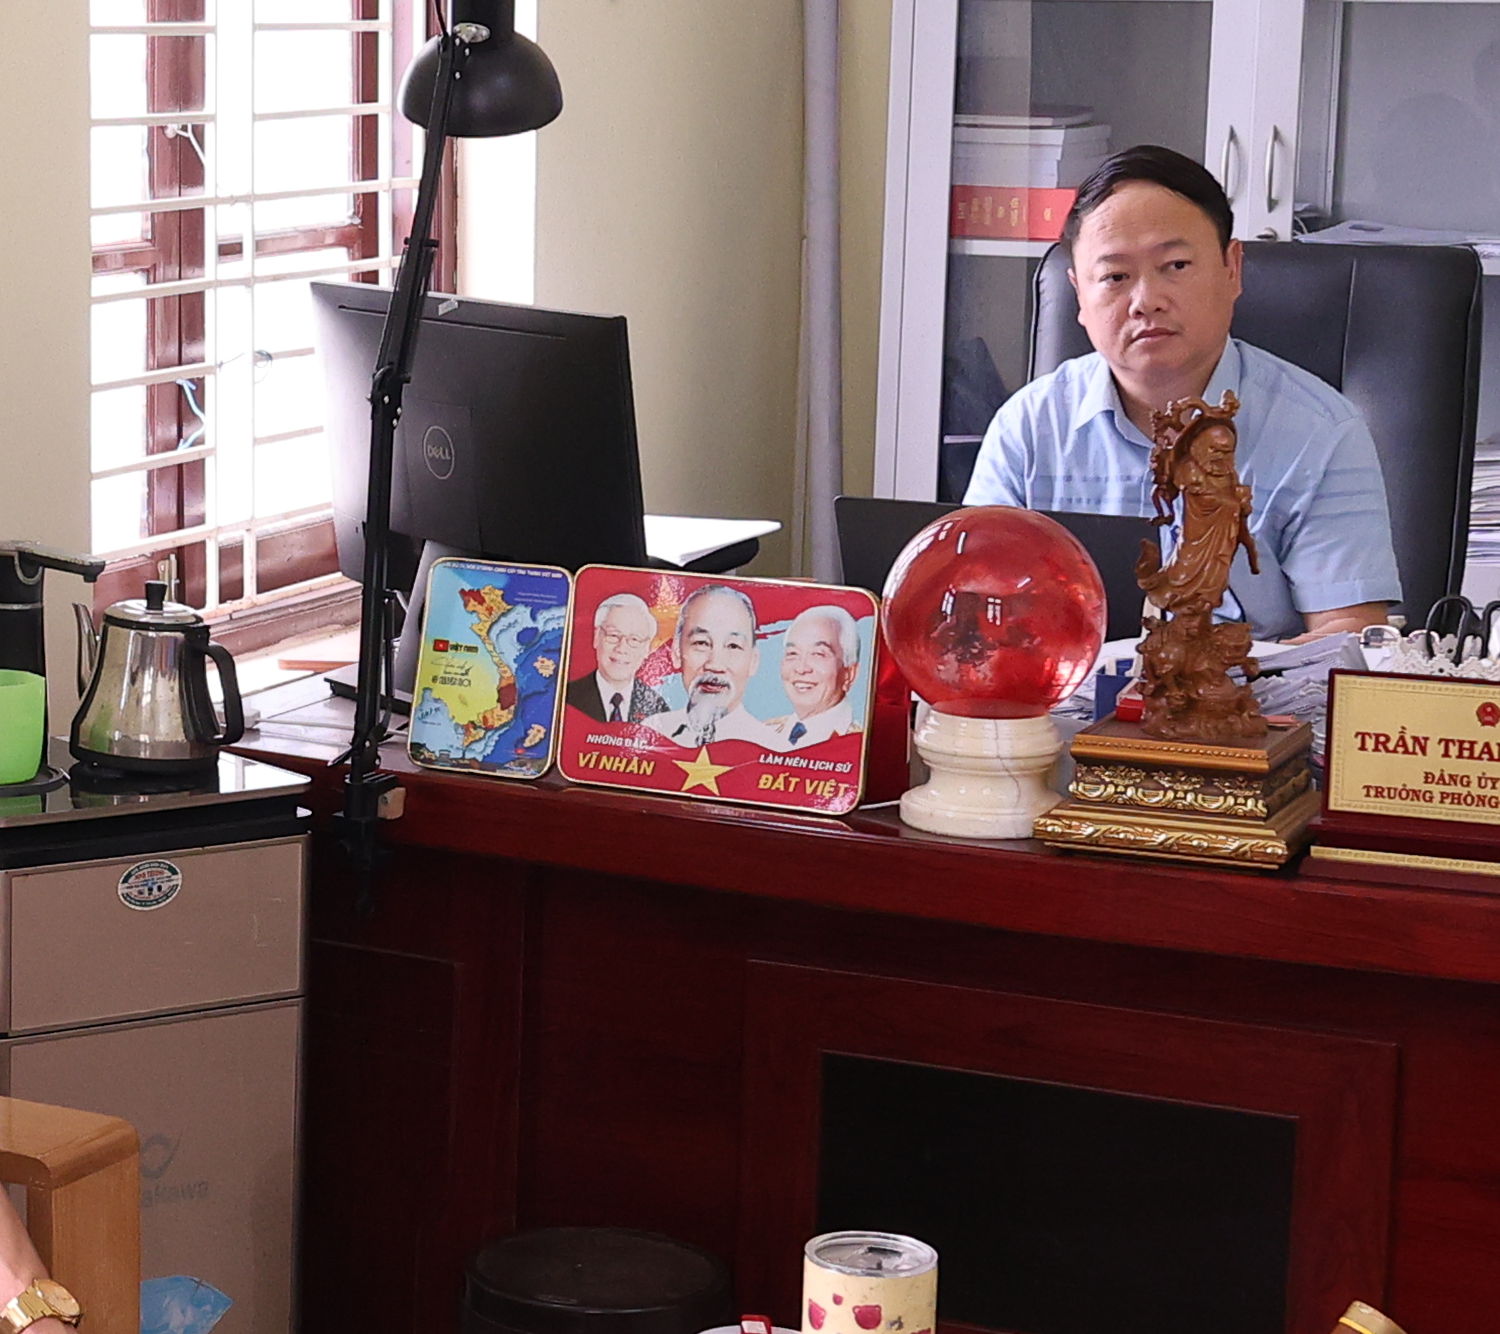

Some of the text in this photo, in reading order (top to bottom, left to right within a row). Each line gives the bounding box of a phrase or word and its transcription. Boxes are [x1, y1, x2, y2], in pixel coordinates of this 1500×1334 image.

[427, 445, 451, 460] DELL
[1355, 726, 1430, 757] TRẦN
[578, 750, 655, 777] VĨ NHÂN
[758, 772, 849, 798] ĐẤT VIỆT
[1423, 770, 1472, 789] ĐẢNG
[1477, 771, 1500, 791] ỦY
[1438, 791, 1500, 809] PHÒNG
